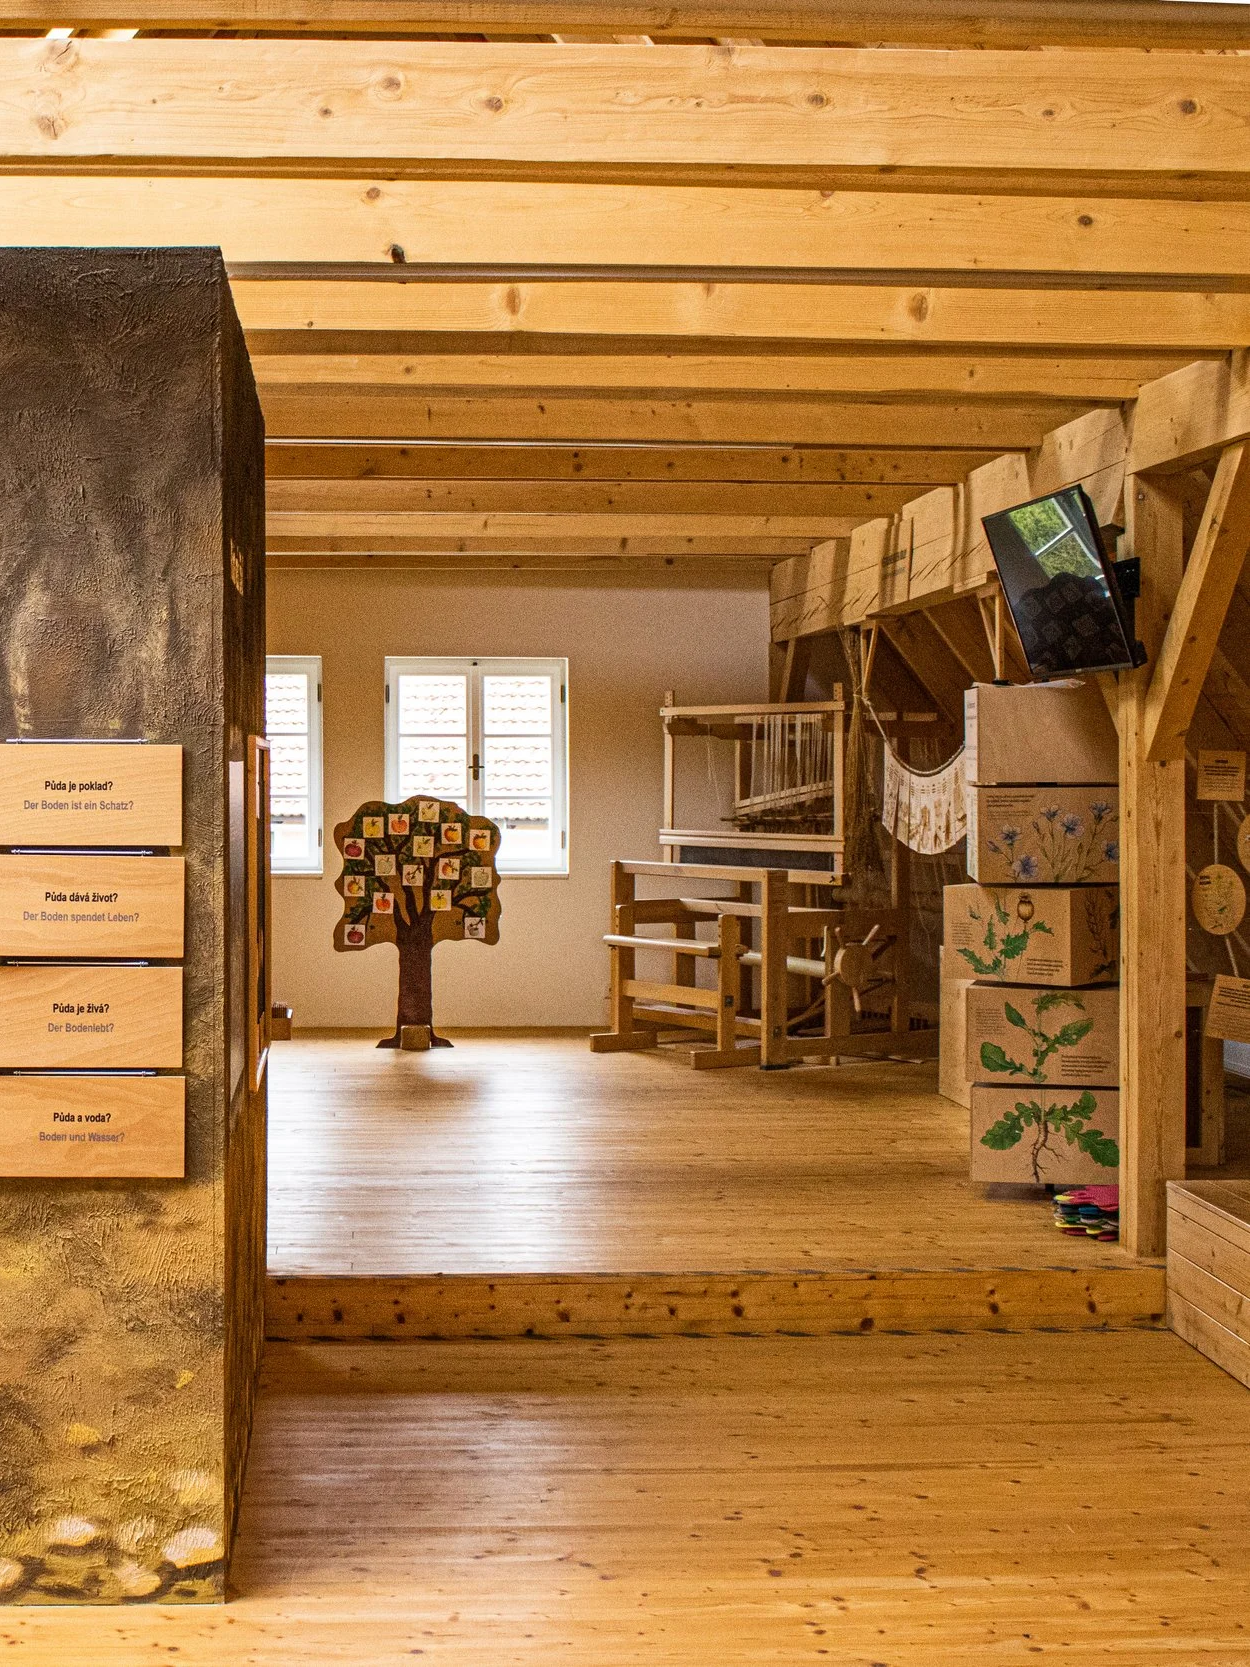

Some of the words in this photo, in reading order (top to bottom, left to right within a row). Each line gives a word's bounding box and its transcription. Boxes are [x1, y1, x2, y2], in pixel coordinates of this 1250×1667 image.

[44, 780, 66, 791] Půda
[68, 781, 77, 792] je
[78, 781, 114, 792] poklad?
[23, 800, 39, 810] Der
[41, 800, 69, 810] Boden
[71, 800, 82, 810] ist
[84, 800, 98, 810] ein
[99, 800, 134, 811] Schatz?
[45, 892, 67, 902] Půda
[69, 892, 90, 902] dává
[92, 892, 118, 903] život?
[23, 911, 39, 921] Der
[40, 911, 68, 922] Boden
[70, 912, 106, 924] spendet
[107, 912, 140, 922] Leben?
[52, 1002, 75, 1014] Půda
[76, 1004, 85, 1016] je
[86, 1003, 110, 1014] živá?
[48, 1022, 64, 1032] Der
[53, 1112, 75, 1122] Půda
[77, 1114, 83, 1122] a
[84, 1112, 112, 1123] voda?
[39, 1132, 67, 1142] Boden
[69, 1132, 86, 1142] und
[88, 1132, 126, 1143] Wasser?
